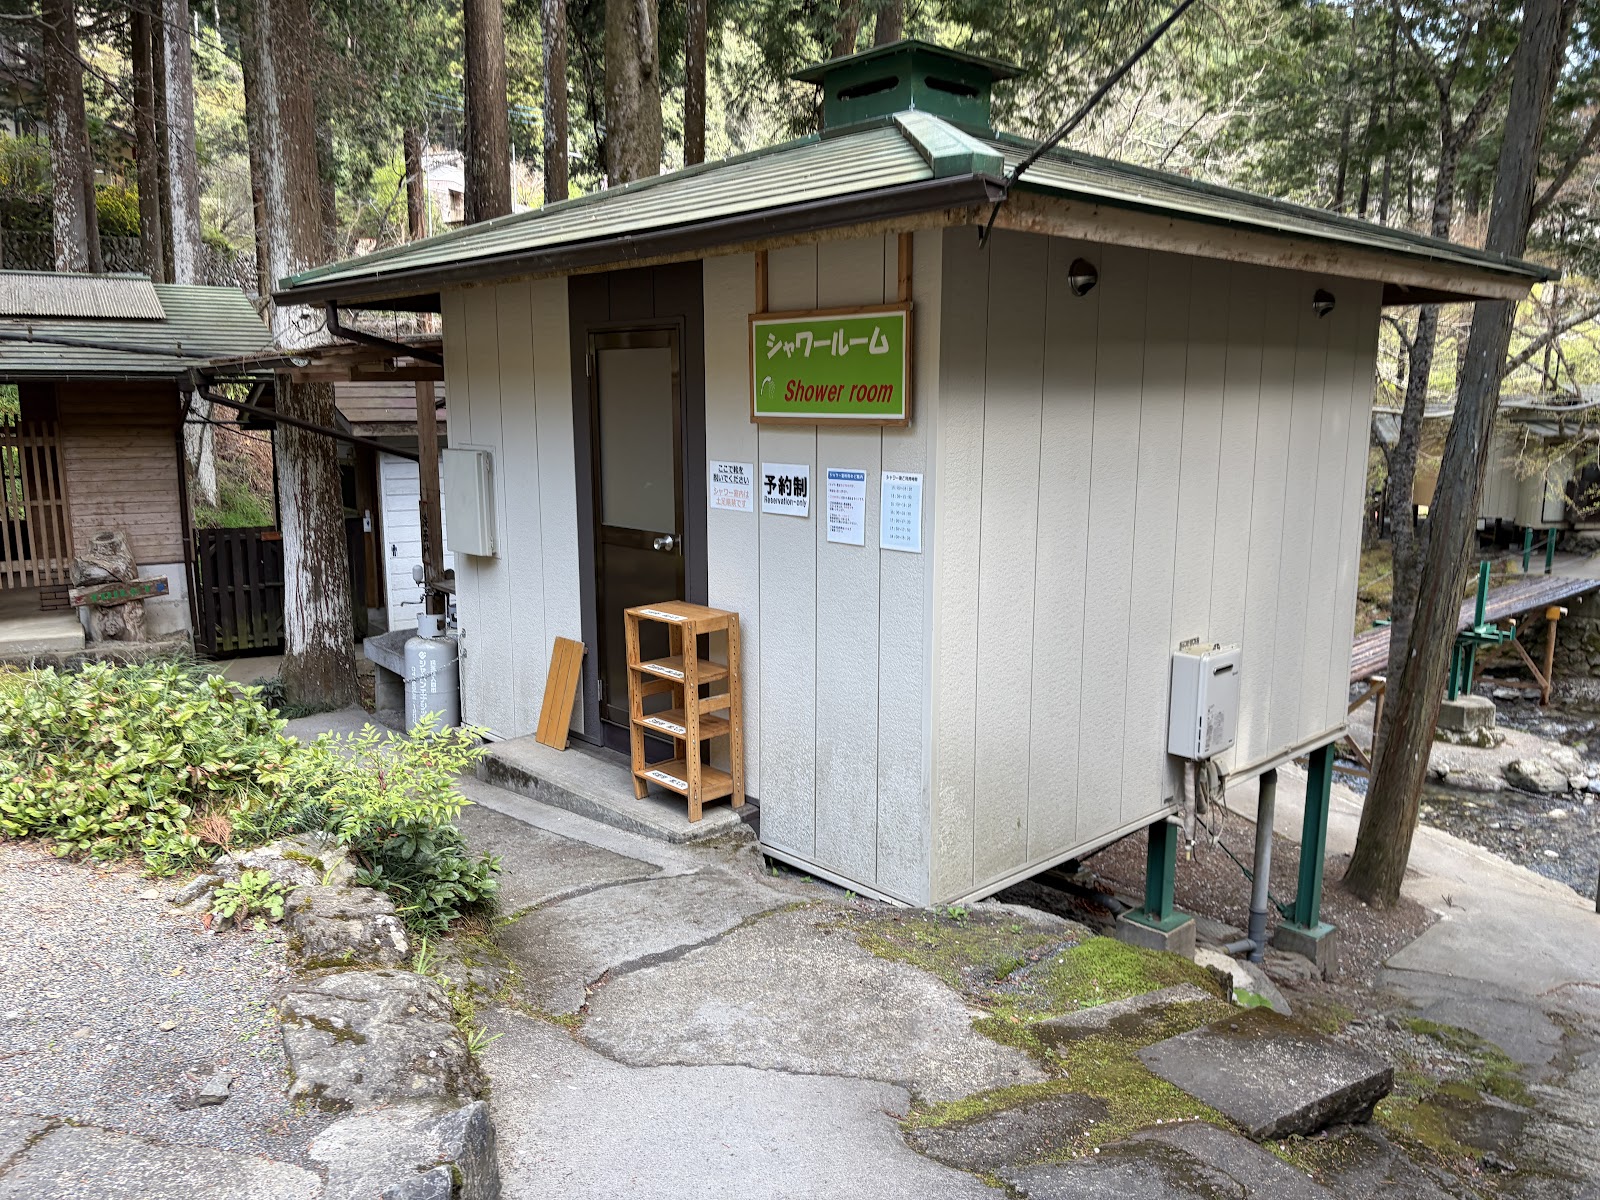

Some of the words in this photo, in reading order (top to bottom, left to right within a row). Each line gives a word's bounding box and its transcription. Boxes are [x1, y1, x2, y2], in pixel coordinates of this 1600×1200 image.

[766, 326, 890, 360] シャワールーム
[784, 379, 845, 403] Shower
[848, 384, 894, 403] room
[763, 475, 808, 498] 予約制
[763, 495, 807, 508] Reservation-only
